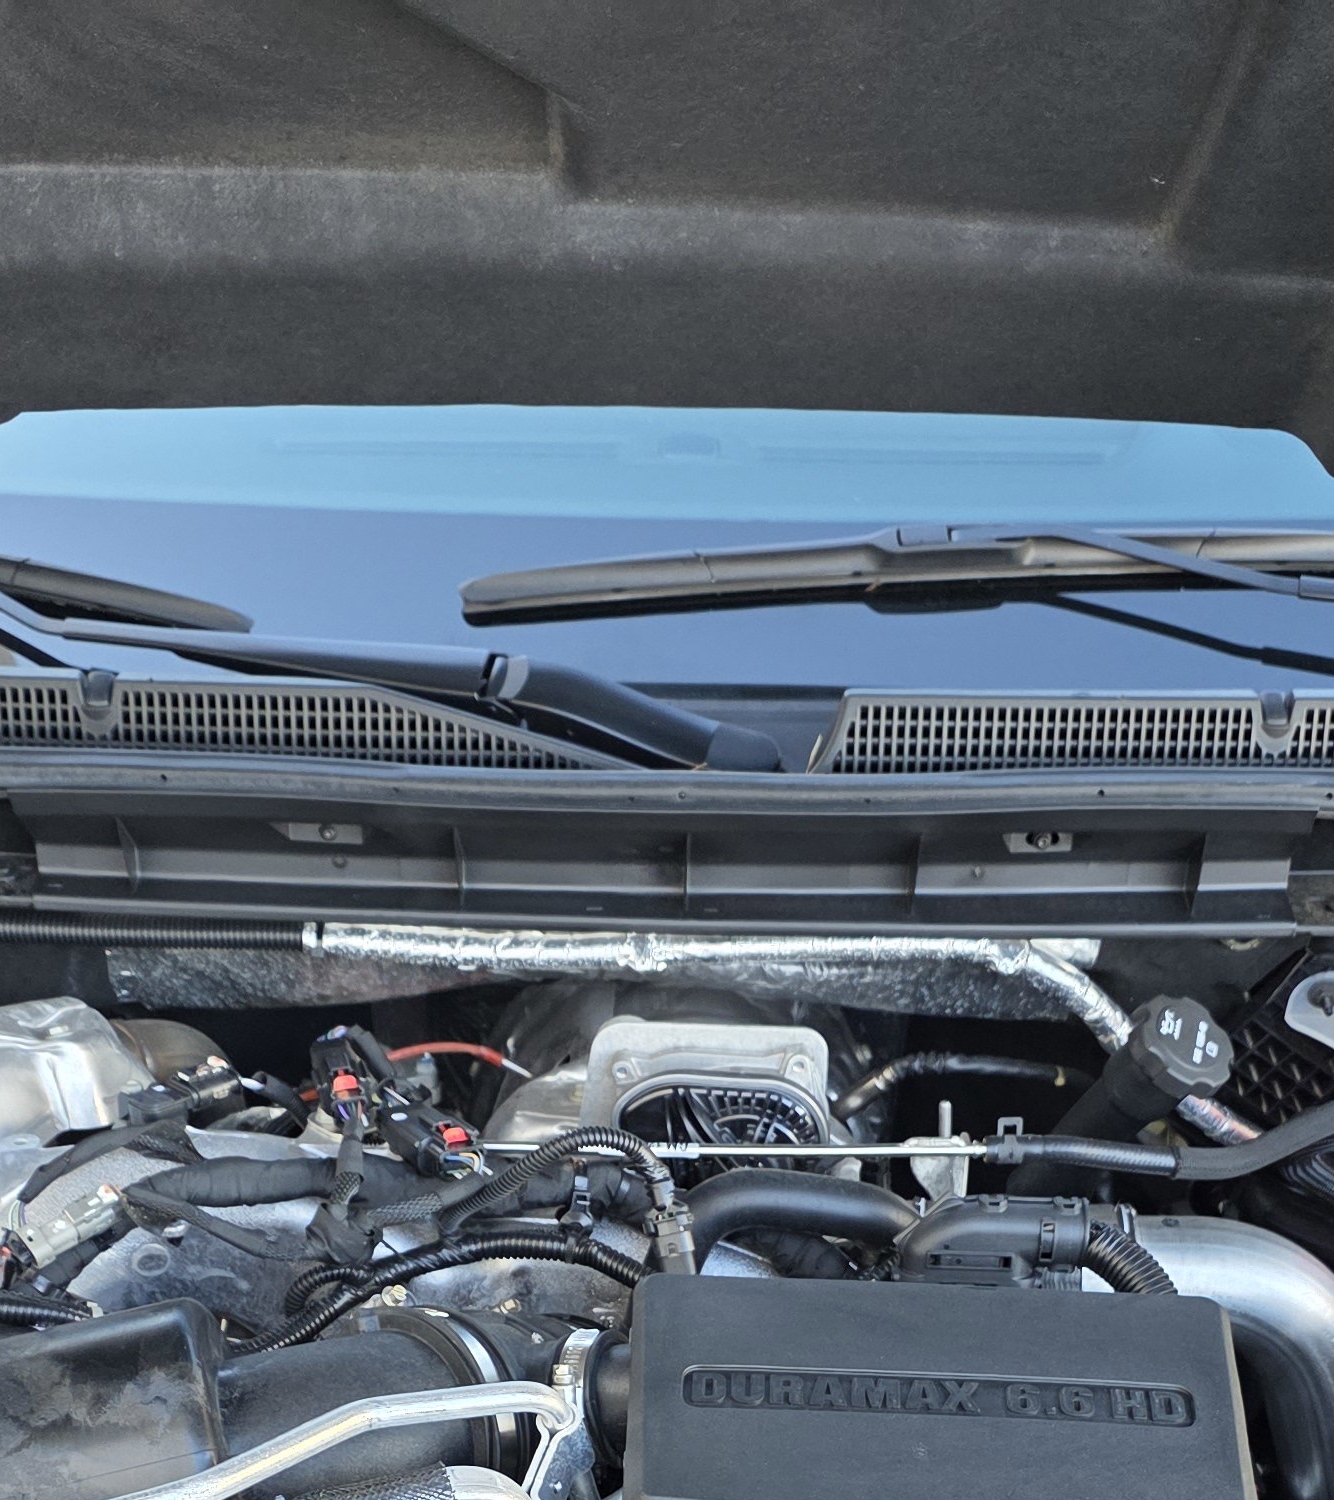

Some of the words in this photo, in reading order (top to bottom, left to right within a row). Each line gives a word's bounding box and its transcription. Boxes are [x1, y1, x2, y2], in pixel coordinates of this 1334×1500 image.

[692, 1372, 980, 1413] DURAMAX
[1004, 1383, 1096, 1419] 6.6
[1110, 1388, 1192, 1426] HD
